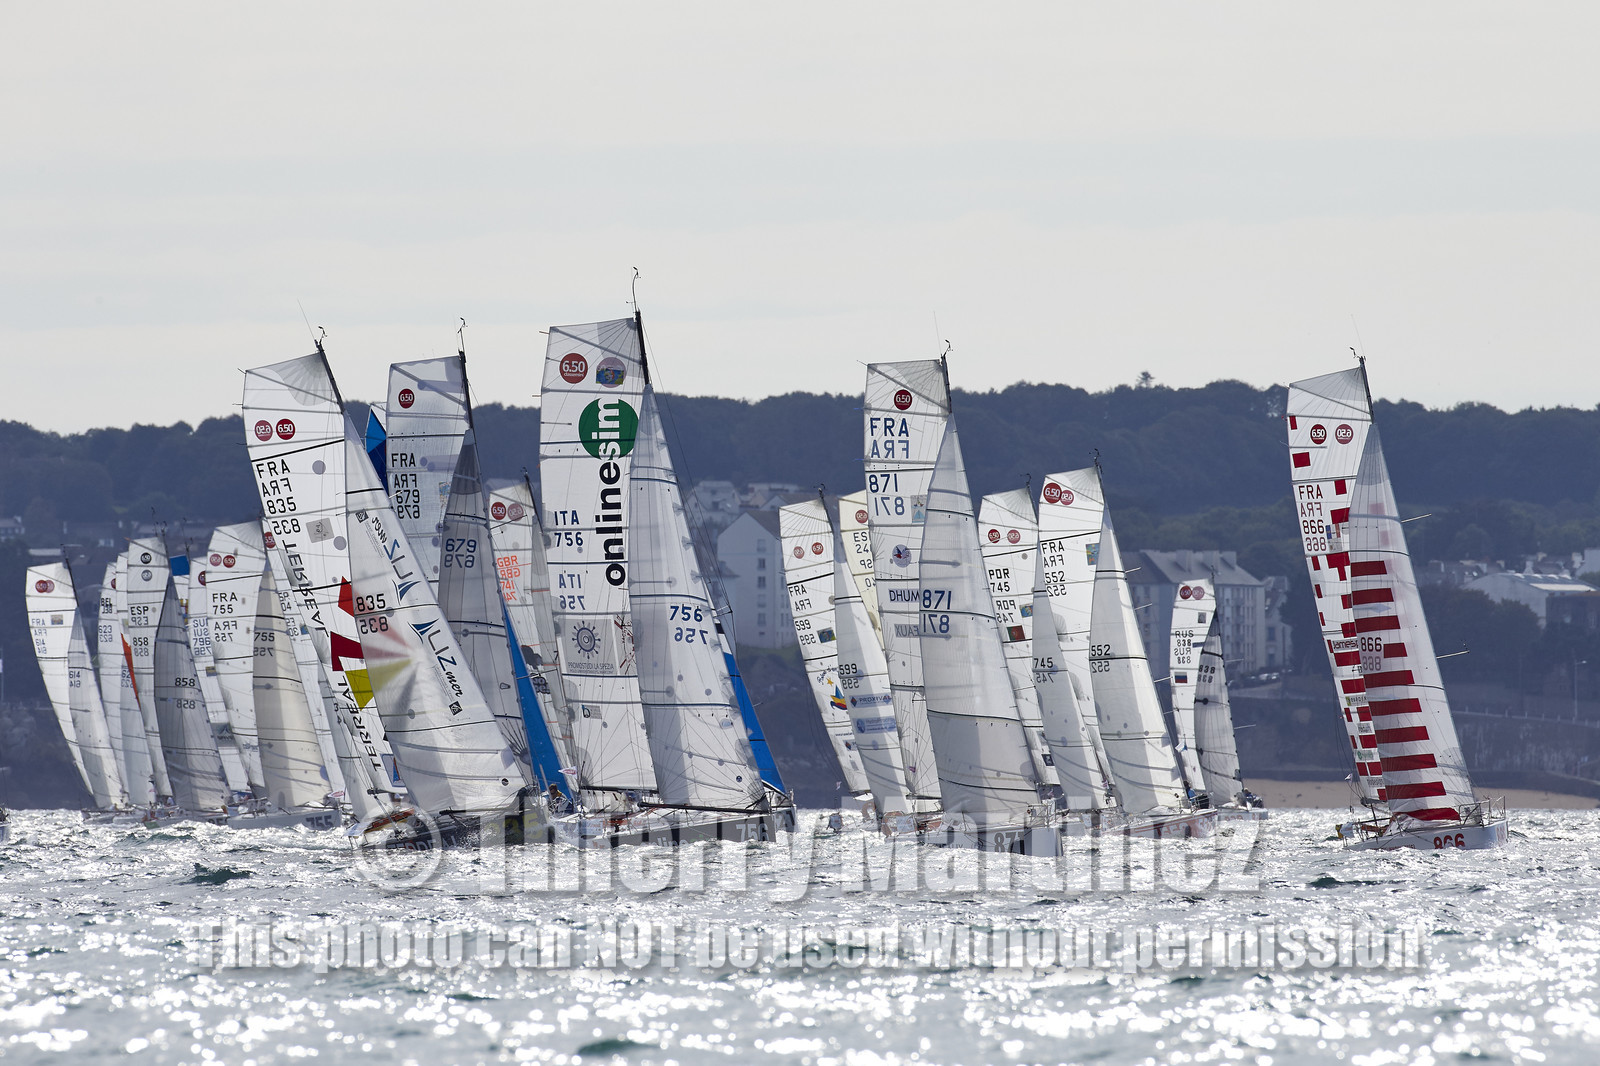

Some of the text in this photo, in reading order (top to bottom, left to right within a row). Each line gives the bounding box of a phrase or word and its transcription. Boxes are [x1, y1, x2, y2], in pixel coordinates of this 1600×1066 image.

[562, 361, 586, 372] 6.50
[400, 393, 413, 402] 6.50
[896, 394, 911, 404] 6.50
[278, 424, 294, 433] 6.50
[870, 418, 910, 437] FRA
[1312, 429, 1325, 438] 6.50
[392, 453, 416, 468] FRA
[256, 459, 290, 478] FRA
[869, 473, 898, 493] 871
[396, 490, 420, 504] 679
[592, 398, 626, 586] onlinesim
[1044, 488, 1061, 497] 6.50
[1298, 484, 1323, 500] FRA
[267, 497, 296, 514] 835
[554, 510, 579, 526] ITA
[1302, 520, 1324, 534] 866
[554, 532, 583, 547] 756
[854, 532, 868, 542] ES
[446, 538, 477, 554] 679
[856, 544, 869, 554] 24
[1042, 540, 1065, 554] FRA
[497, 555, 518, 568] GBR
[989, 568, 1009, 580] POR
[1044, 571, 1065, 583] 552
[500, 580, 514, 590] 741
[789, 584, 807, 597] FRA
[990, 582, 1010, 593] 745
[212, 592, 238, 602] FRA
[889, 590, 919, 601] DHUM
[923, 589, 951, 610] 871
[356, 593, 386, 612] 835
[130, 606, 149, 616] ESP
[213, 605, 234, 615] 755
[670, 605, 703, 622] 756
[794, 620, 811, 631] 599
[254, 632, 275, 642] 755
[1175, 630, 1194, 638] RUS
[133, 637, 149, 646] 858
[193, 638, 210, 646] 796
[1177, 639, 1192, 647] 838
[1361, 637, 1382, 652] 866
[1091, 644, 1110, 657] 552
[839, 663, 857, 675] 599
[1034, 658, 1053, 668] 745
[1199, 664, 1215, 674] 838
[122, 670, 131, 678] 62
[175, 678, 195, 687] 858
[338, 676, 381, 772] TERREAL
[736, 824, 770, 842] 756
[994, 832, 1025, 854] 871
